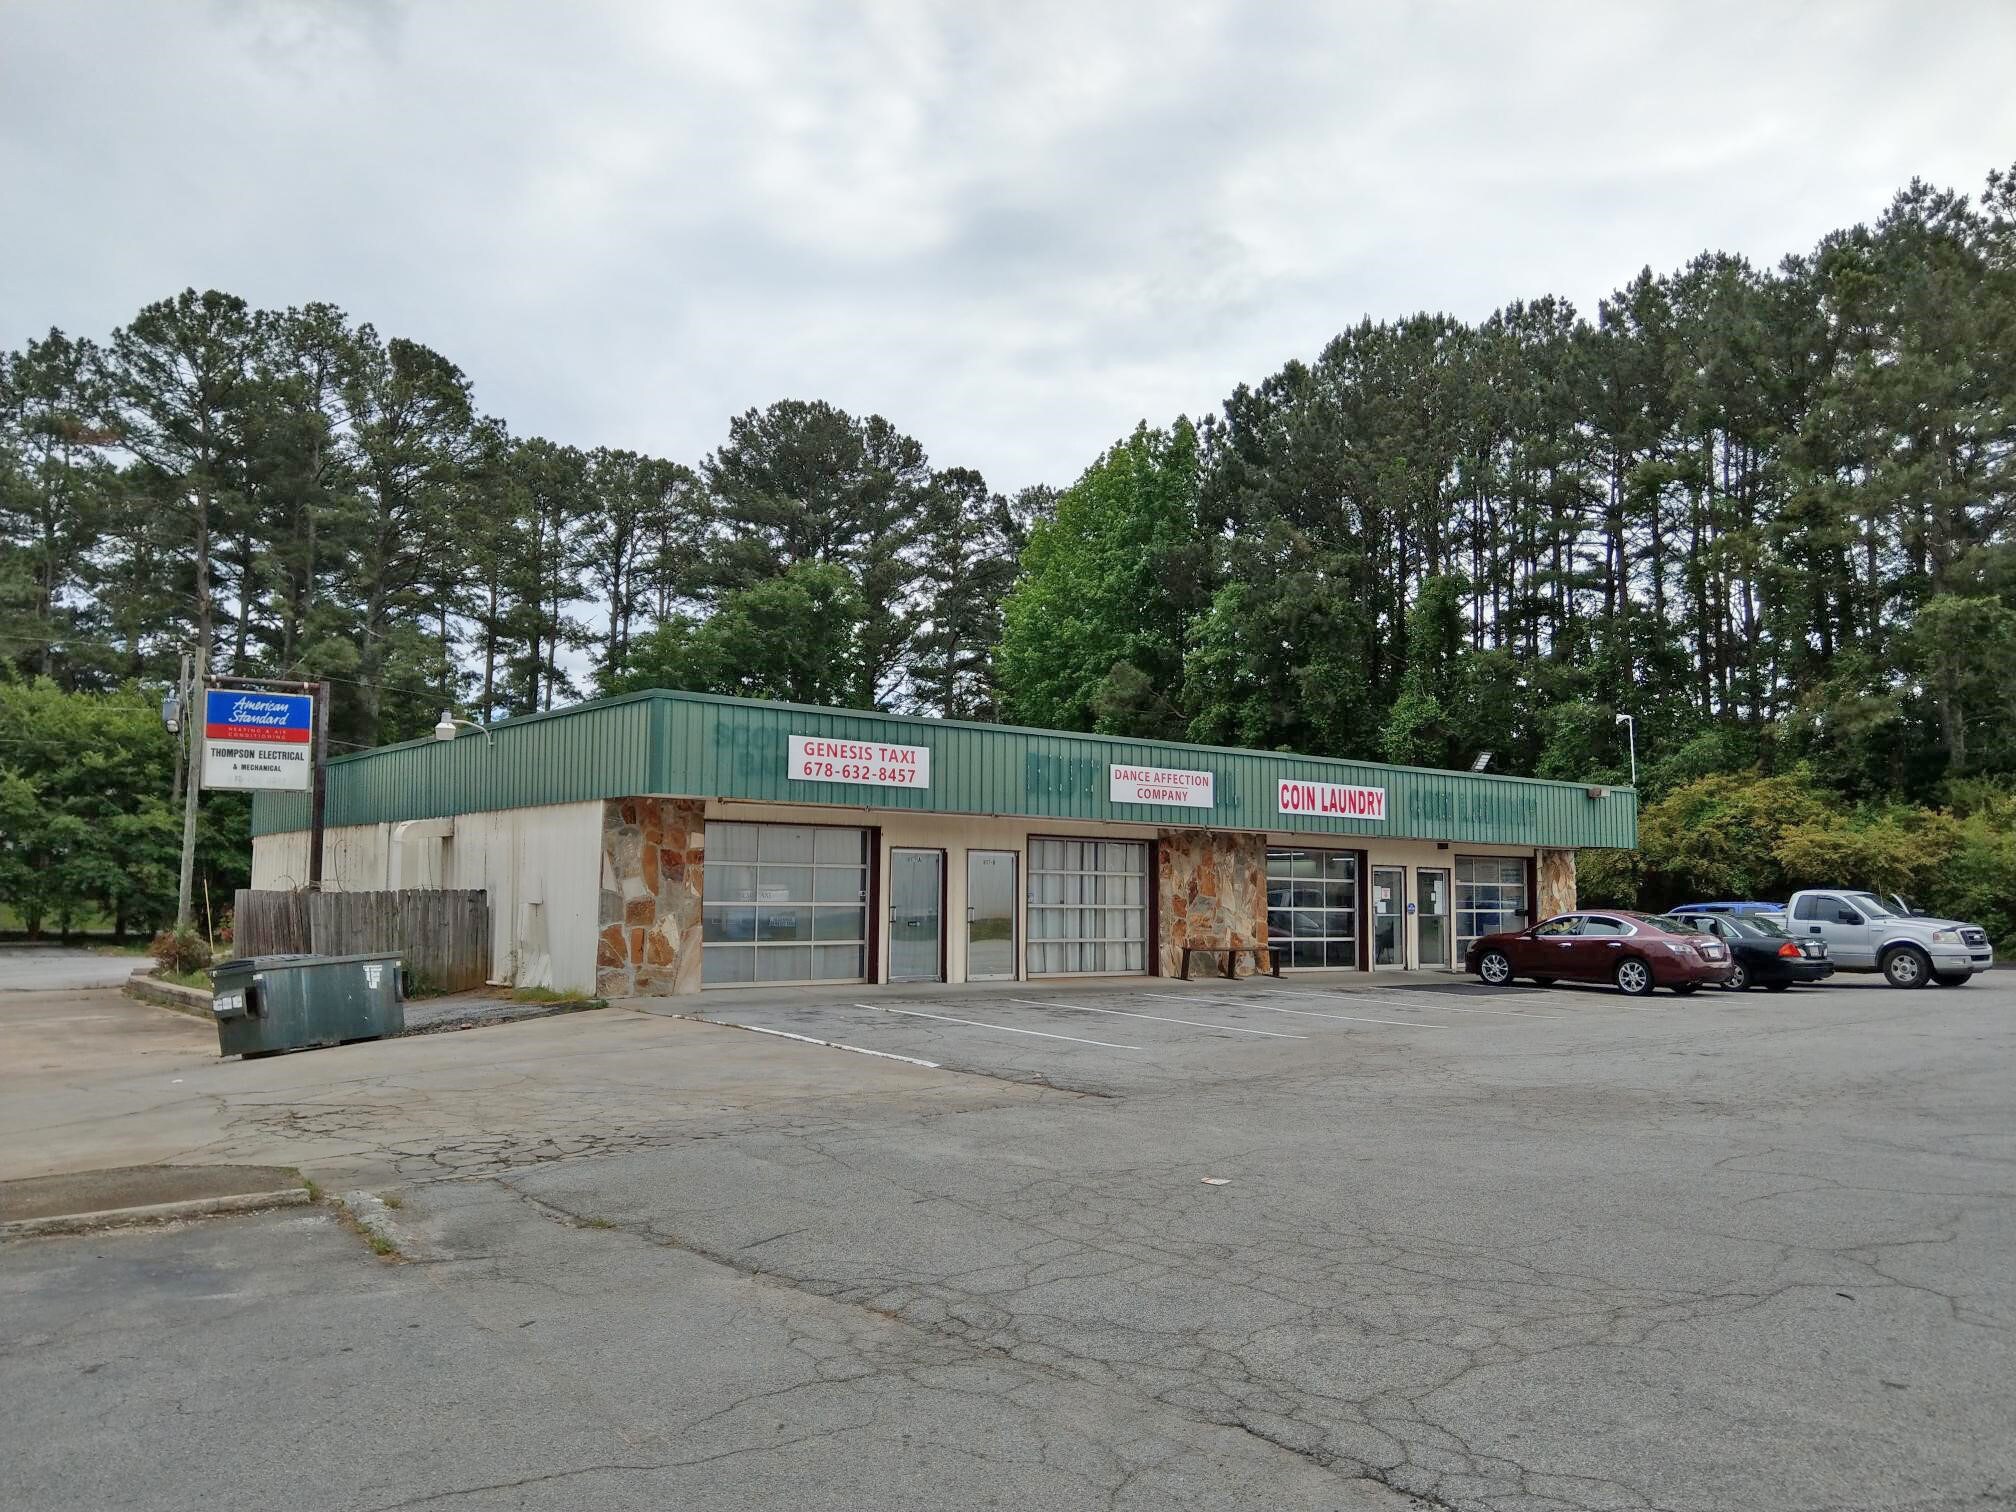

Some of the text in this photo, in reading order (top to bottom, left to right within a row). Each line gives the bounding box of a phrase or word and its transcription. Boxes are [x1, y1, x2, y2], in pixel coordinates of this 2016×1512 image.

[233, 696, 289, 712] American
[229, 710, 289, 725] Standard
[211, 748, 305, 761] THOMPSON ELECTRICAL
[804, 741, 916, 764] GENESIS TAXI
[241, 764, 282, 772] MECHANICAL
[803, 761, 916, 783] 678-632-8457
[1114, 769, 1209, 787] DANCE AFFECTION
[1137, 788, 1188, 802] COMPANY
[1280, 783, 1316, 811] COIN
[1321, 787, 1384, 816] LAUNDRY
